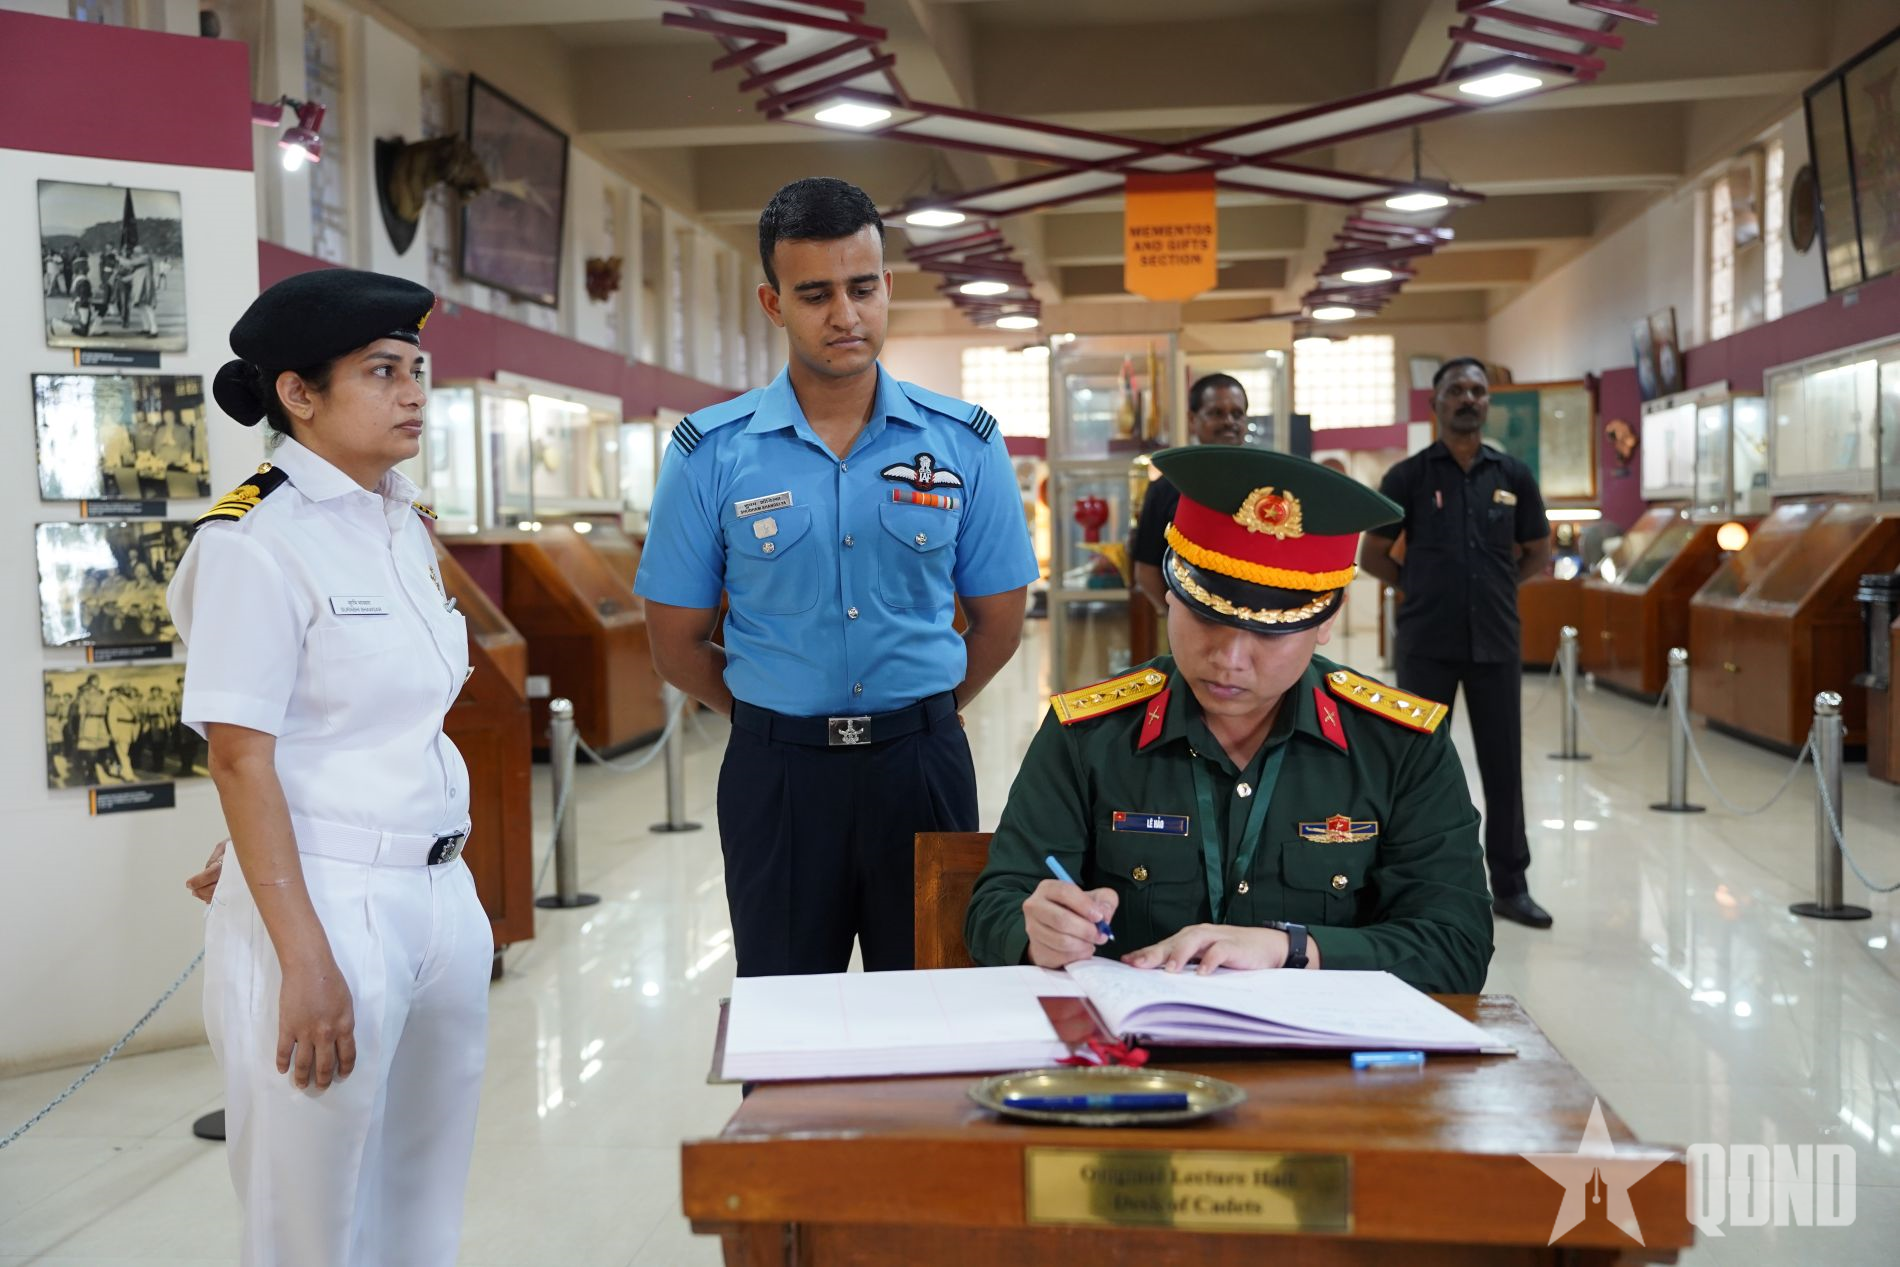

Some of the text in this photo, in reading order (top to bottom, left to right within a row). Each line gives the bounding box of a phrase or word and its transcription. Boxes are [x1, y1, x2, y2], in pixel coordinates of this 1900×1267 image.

[1130, 224, 1212, 236] MEMENTOS
[1134, 239, 1208, 251] AND GIFTS
[1140, 255, 1202, 266] SECTION
[1171, 1168, 1246, 1187] Lecture
[1193, 1197, 1263, 1216] Cadets
